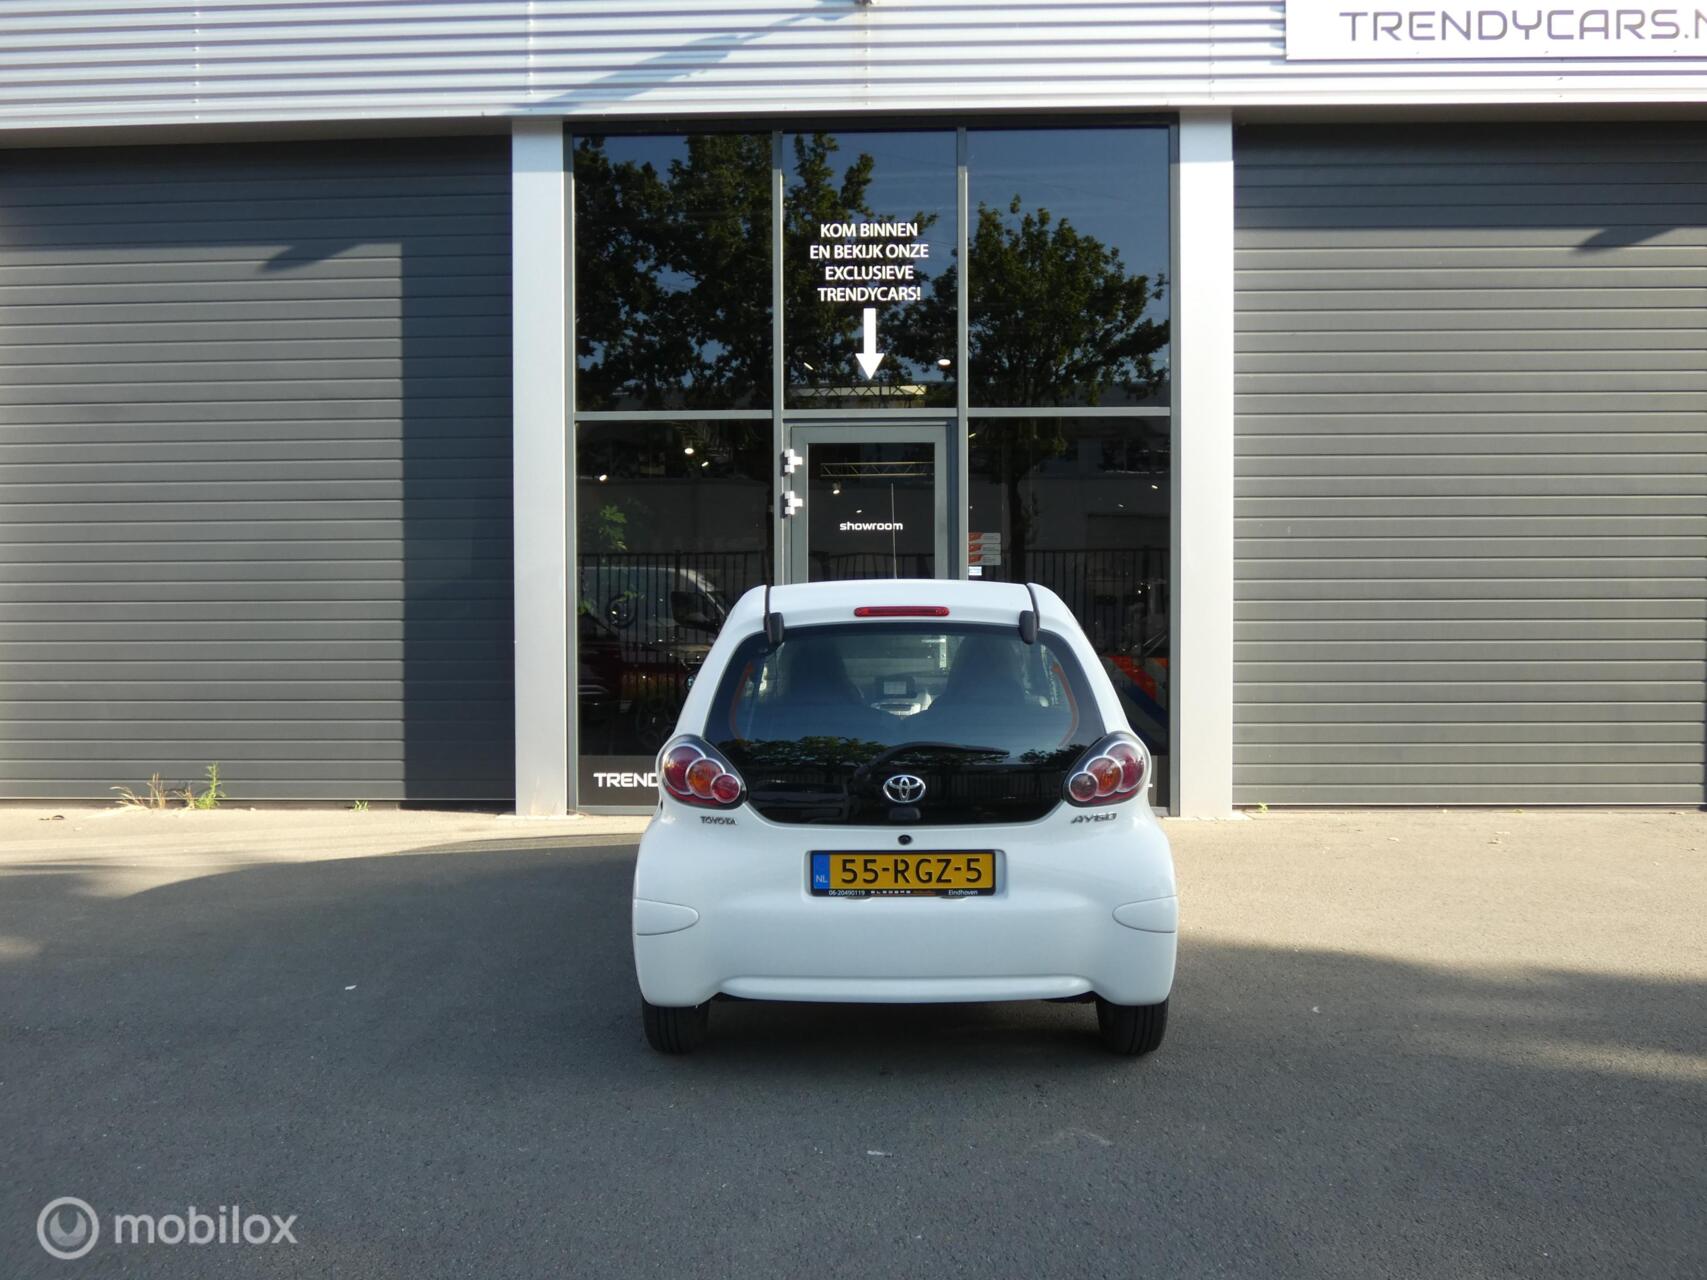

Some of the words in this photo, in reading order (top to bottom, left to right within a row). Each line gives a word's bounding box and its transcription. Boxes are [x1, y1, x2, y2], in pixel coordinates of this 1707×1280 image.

[820, 223, 856, 238] KOM
[860, 222, 918, 237] BINNEN
[810, 245, 830, 259] EN
[834, 244, 883, 259] BEKIJK
[885, 243, 929, 258] ONZE
[825, 265, 914, 280] EXCLUSIEVE
[817, 286, 921, 302] TRENDYCARS!
[839, 521, 904, 531] showroom
[700, 816, 737, 825] TOYOTA
[841, 857, 983, 884] 55-RGZ-5
[815, 875, 828, 884] NL
